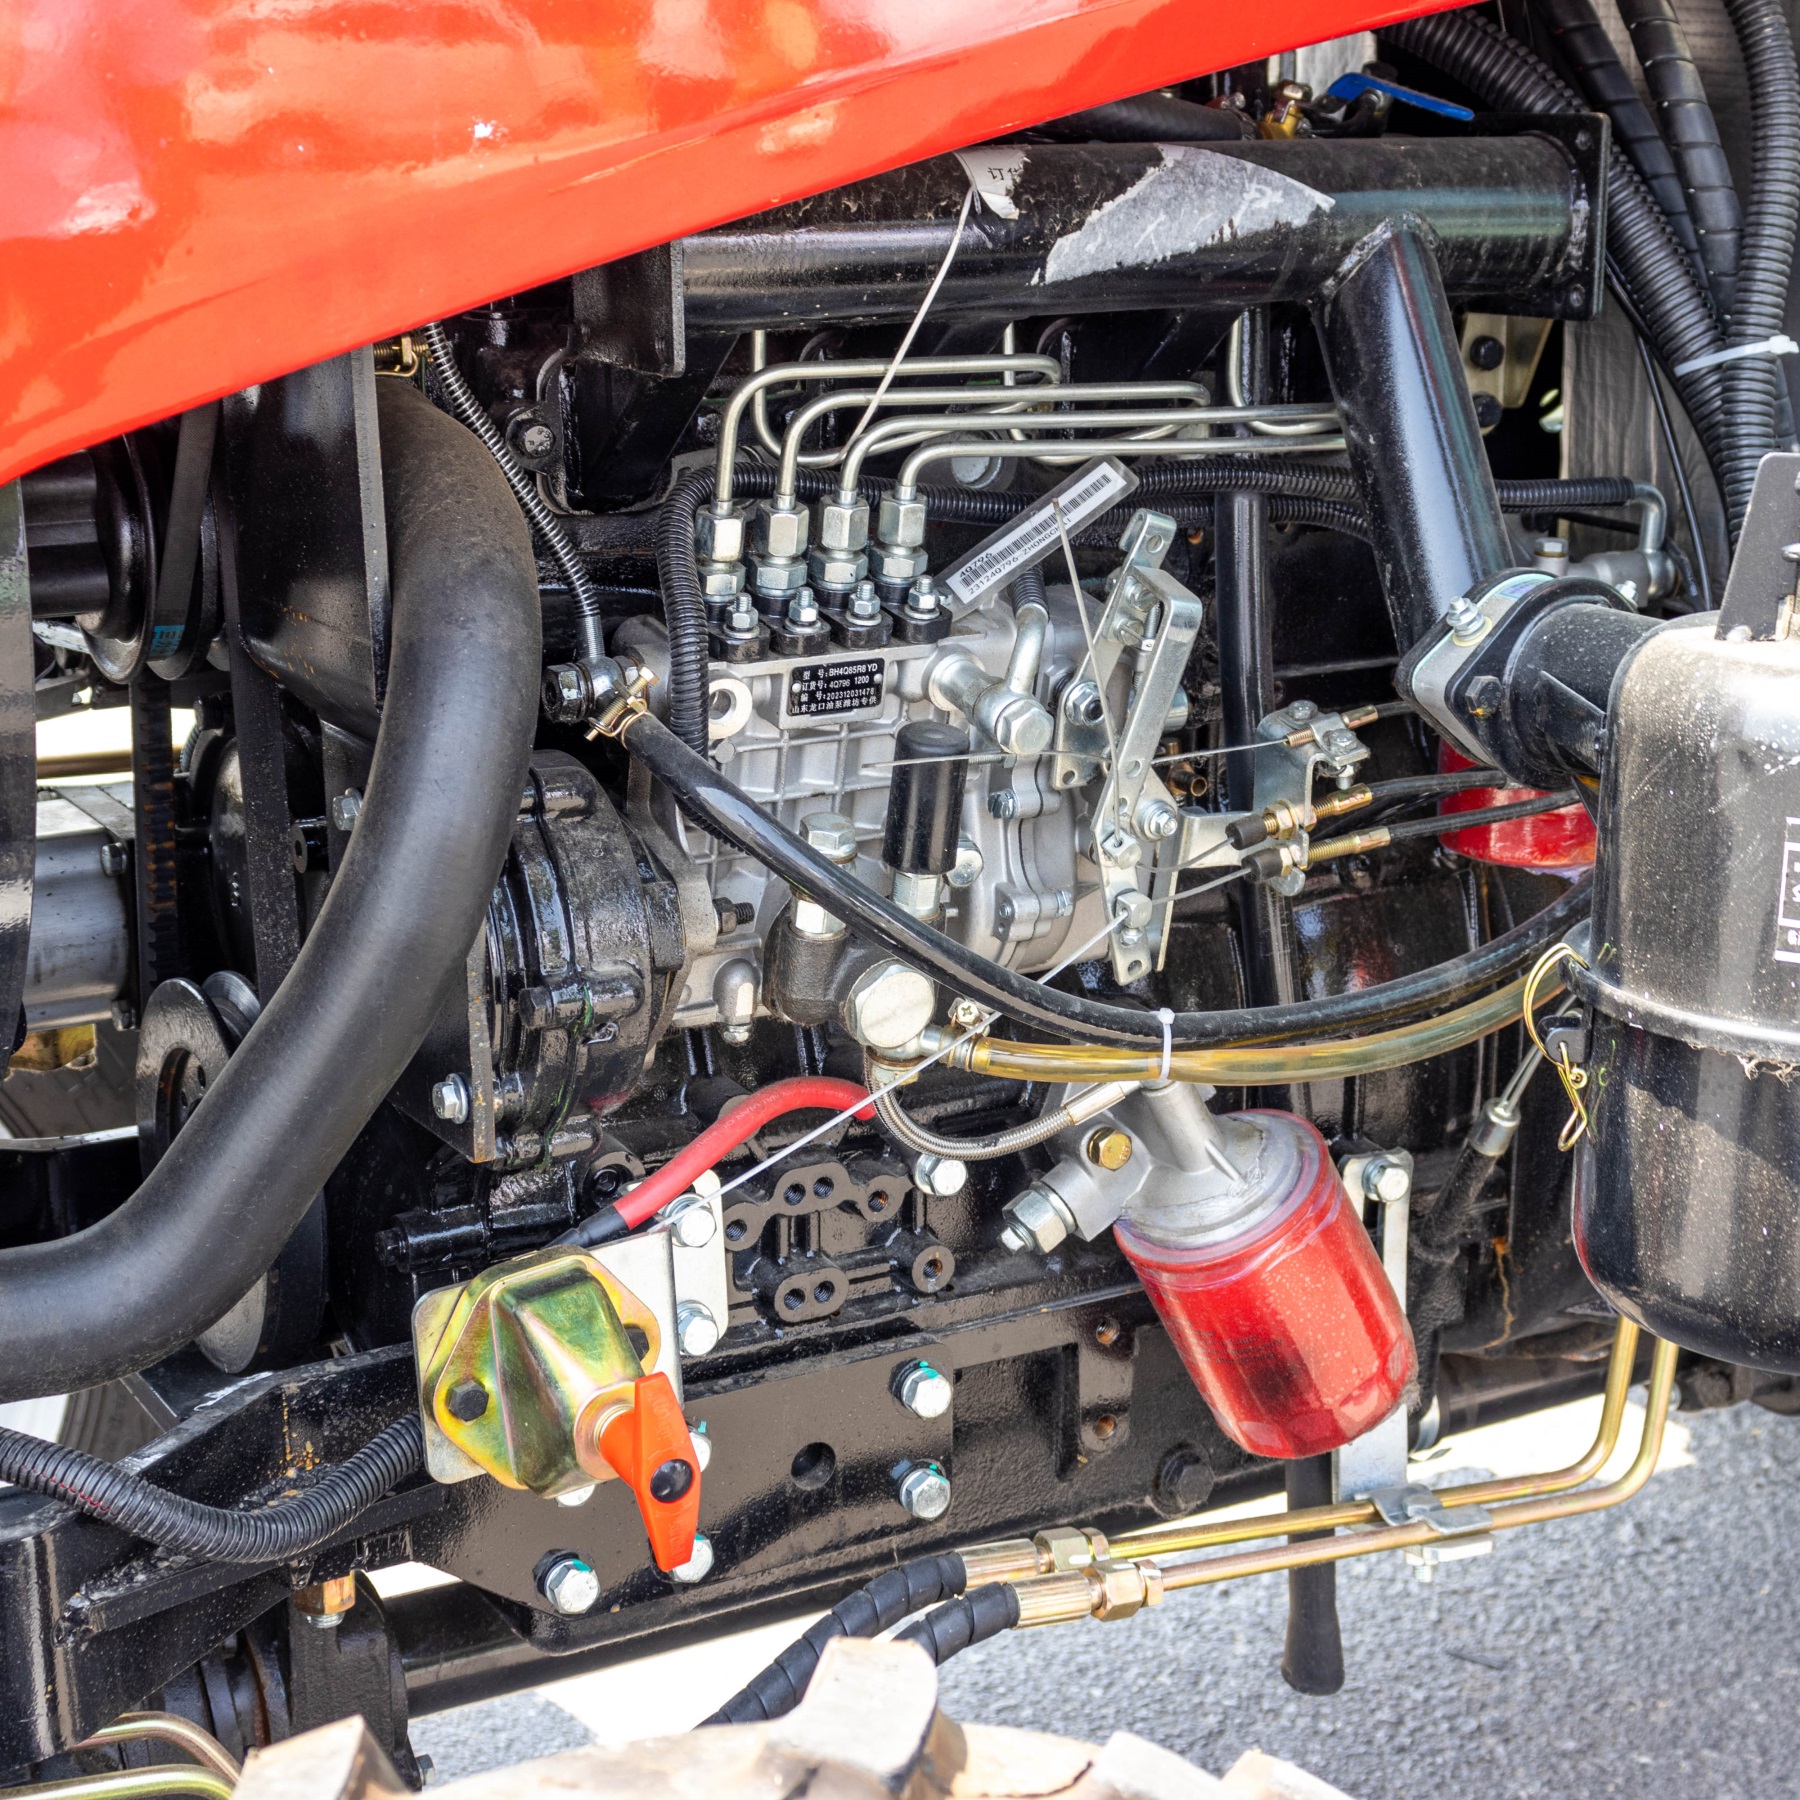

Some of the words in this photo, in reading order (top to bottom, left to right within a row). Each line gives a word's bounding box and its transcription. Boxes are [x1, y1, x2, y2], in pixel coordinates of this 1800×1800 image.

[959, 551, 993, 578] 4Q796
[867, 663, 878, 672] YD
[829, 679, 851, 689] 4Q796
[854, 675, 870, 685] 1200
[826, 687, 875, 700] 202312031478
